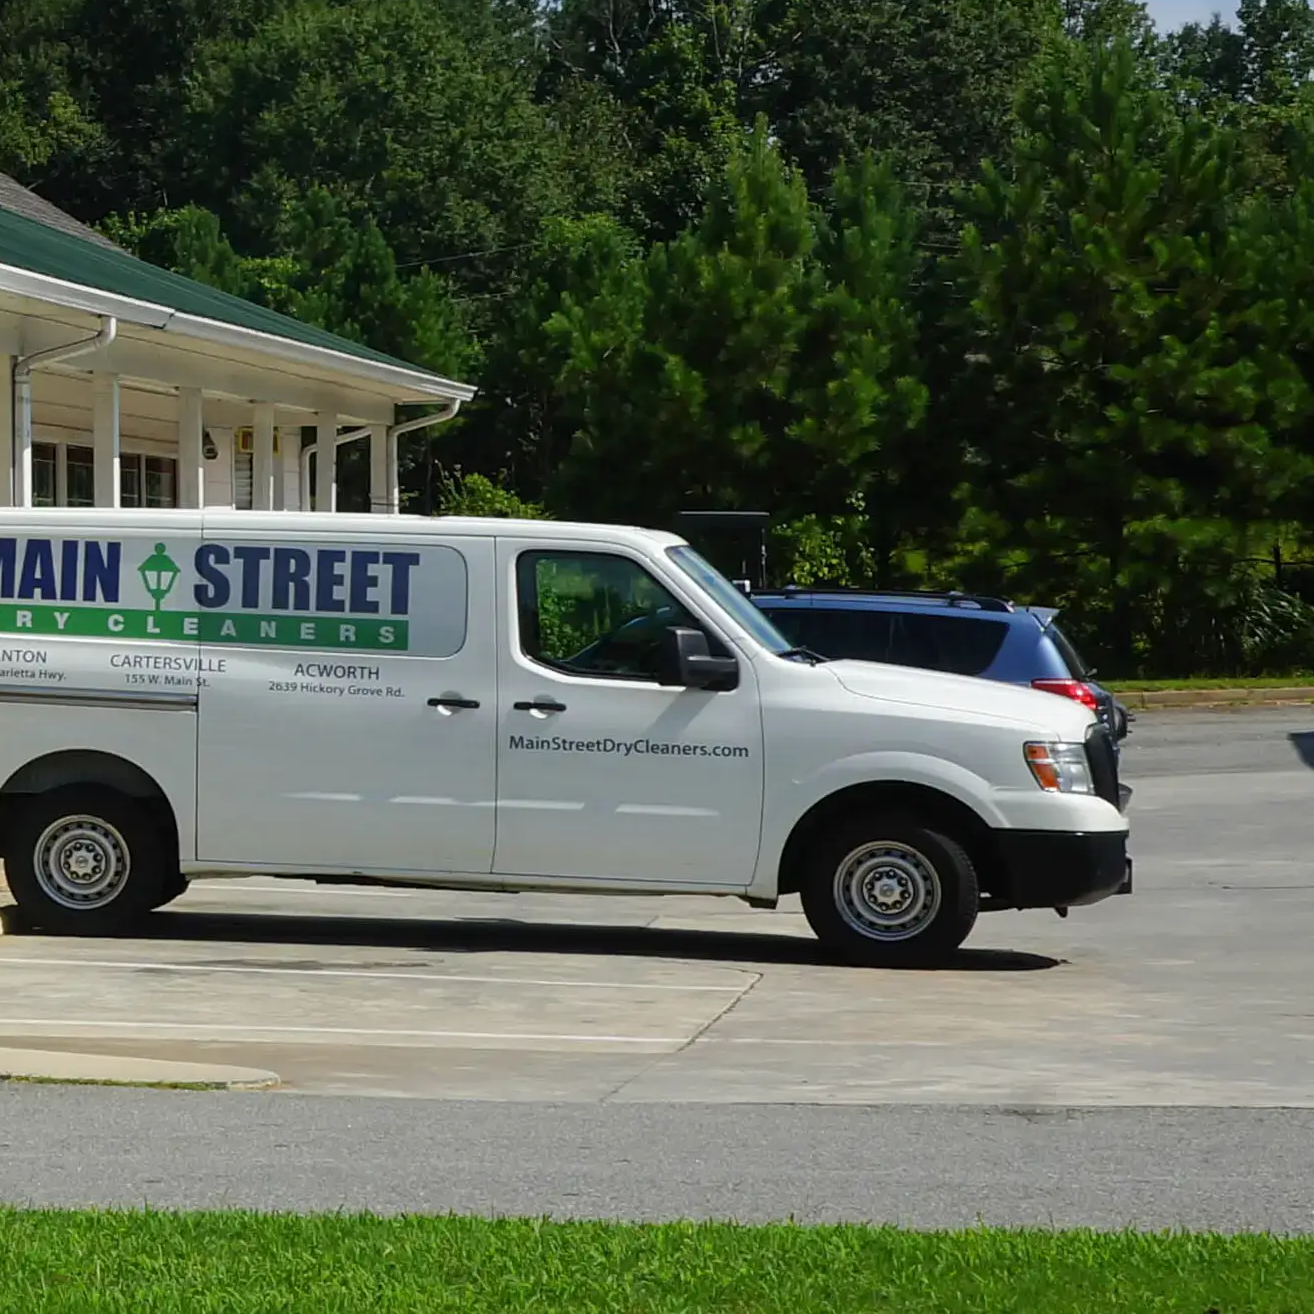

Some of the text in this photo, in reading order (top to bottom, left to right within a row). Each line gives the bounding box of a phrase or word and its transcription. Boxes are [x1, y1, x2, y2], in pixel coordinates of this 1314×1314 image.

[193, 543, 420, 615] STREET
[107, 614, 395, 643] CLEANERS
[110, 654, 227, 673] CARTERSVILLE
[294, 663, 380, 681] ACWORTH
[39, 668, 67, 682] Hwy.
[125, 673, 146, 685] 155
[164, 675, 193, 686] Main
[268, 680, 405, 698] 2639 Hickory Grove Rd.
[508, 735, 750, 758] MainStreetDryCleaners.com
